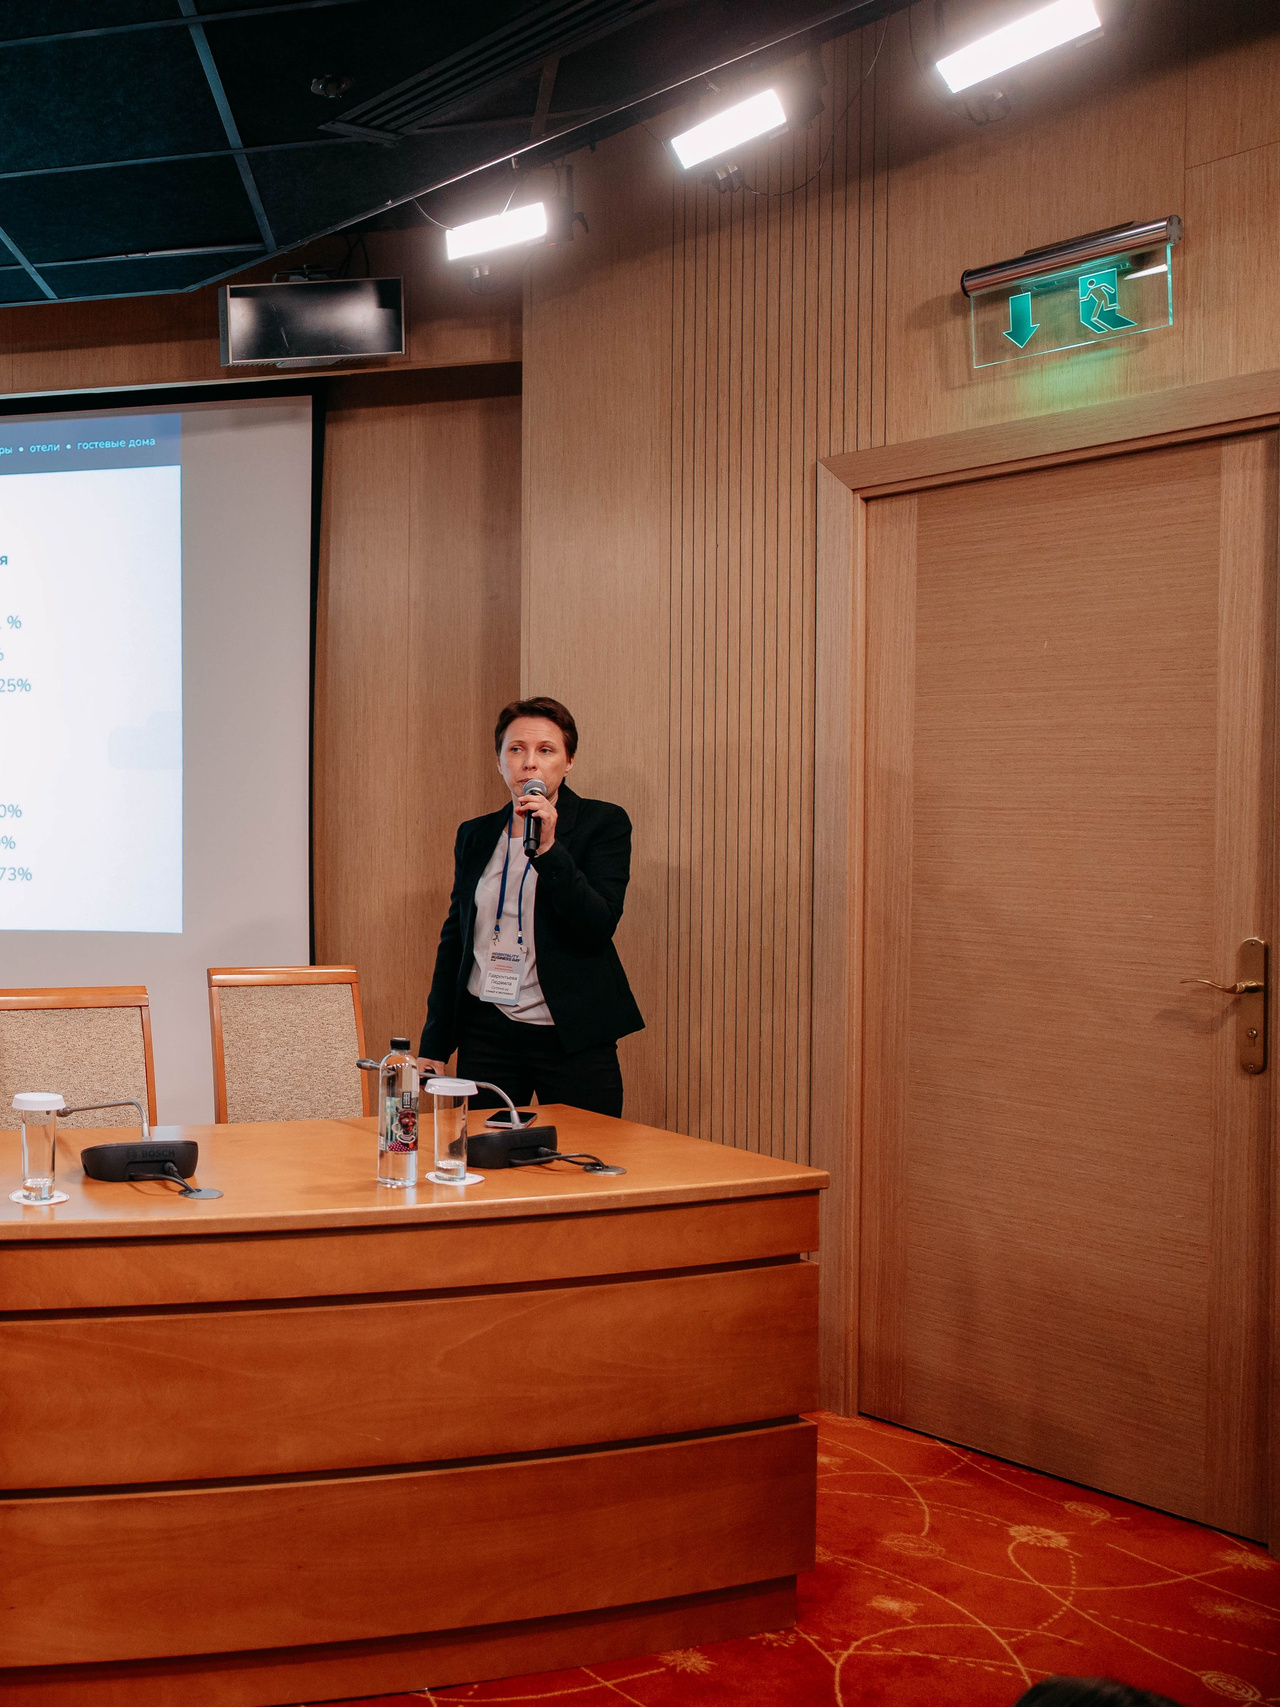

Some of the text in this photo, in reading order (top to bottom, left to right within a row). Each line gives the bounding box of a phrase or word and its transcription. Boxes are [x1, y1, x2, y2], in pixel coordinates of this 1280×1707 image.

[29, 443, 60, 453] отели
[77, 439, 126, 450] гостевые
[128, 437, 156, 448] дома
[7, 615, 22, 629] %
[141, 1149, 175, 1158] BOSCH
